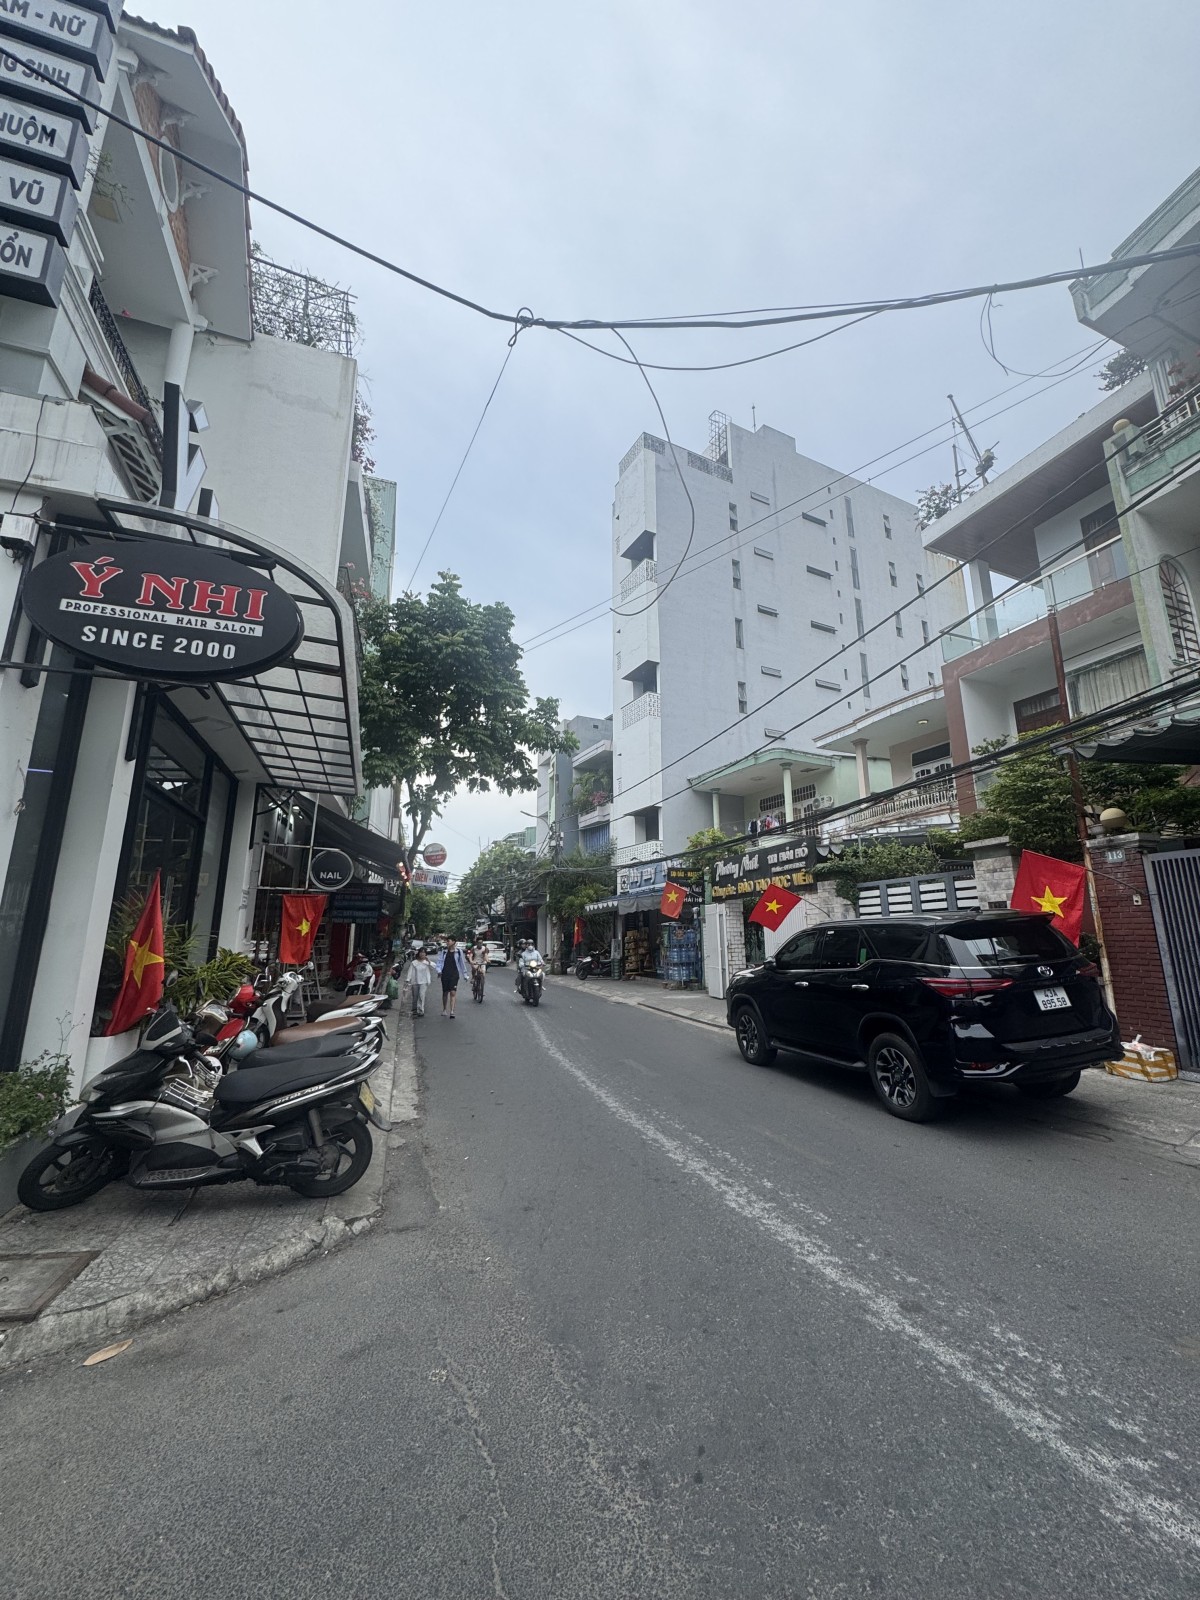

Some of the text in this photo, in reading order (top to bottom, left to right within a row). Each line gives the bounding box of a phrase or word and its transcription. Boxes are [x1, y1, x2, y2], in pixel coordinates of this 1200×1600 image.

[49, 11, 87, 37] NỮ
[0, 52, 18, 72] G
[9, 176, 45, 205] VŨ
[0, 231, 33, 269] ỔN
[70, 556, 269, 622] Ý NHI
[65, 601, 256, 636] PROFESSIONAL HAIR SALON
[81, 624, 236, 660] SINCE 2000
[1107, 850, 1123, 860] 113
[320, 871, 343, 880] NAIL
